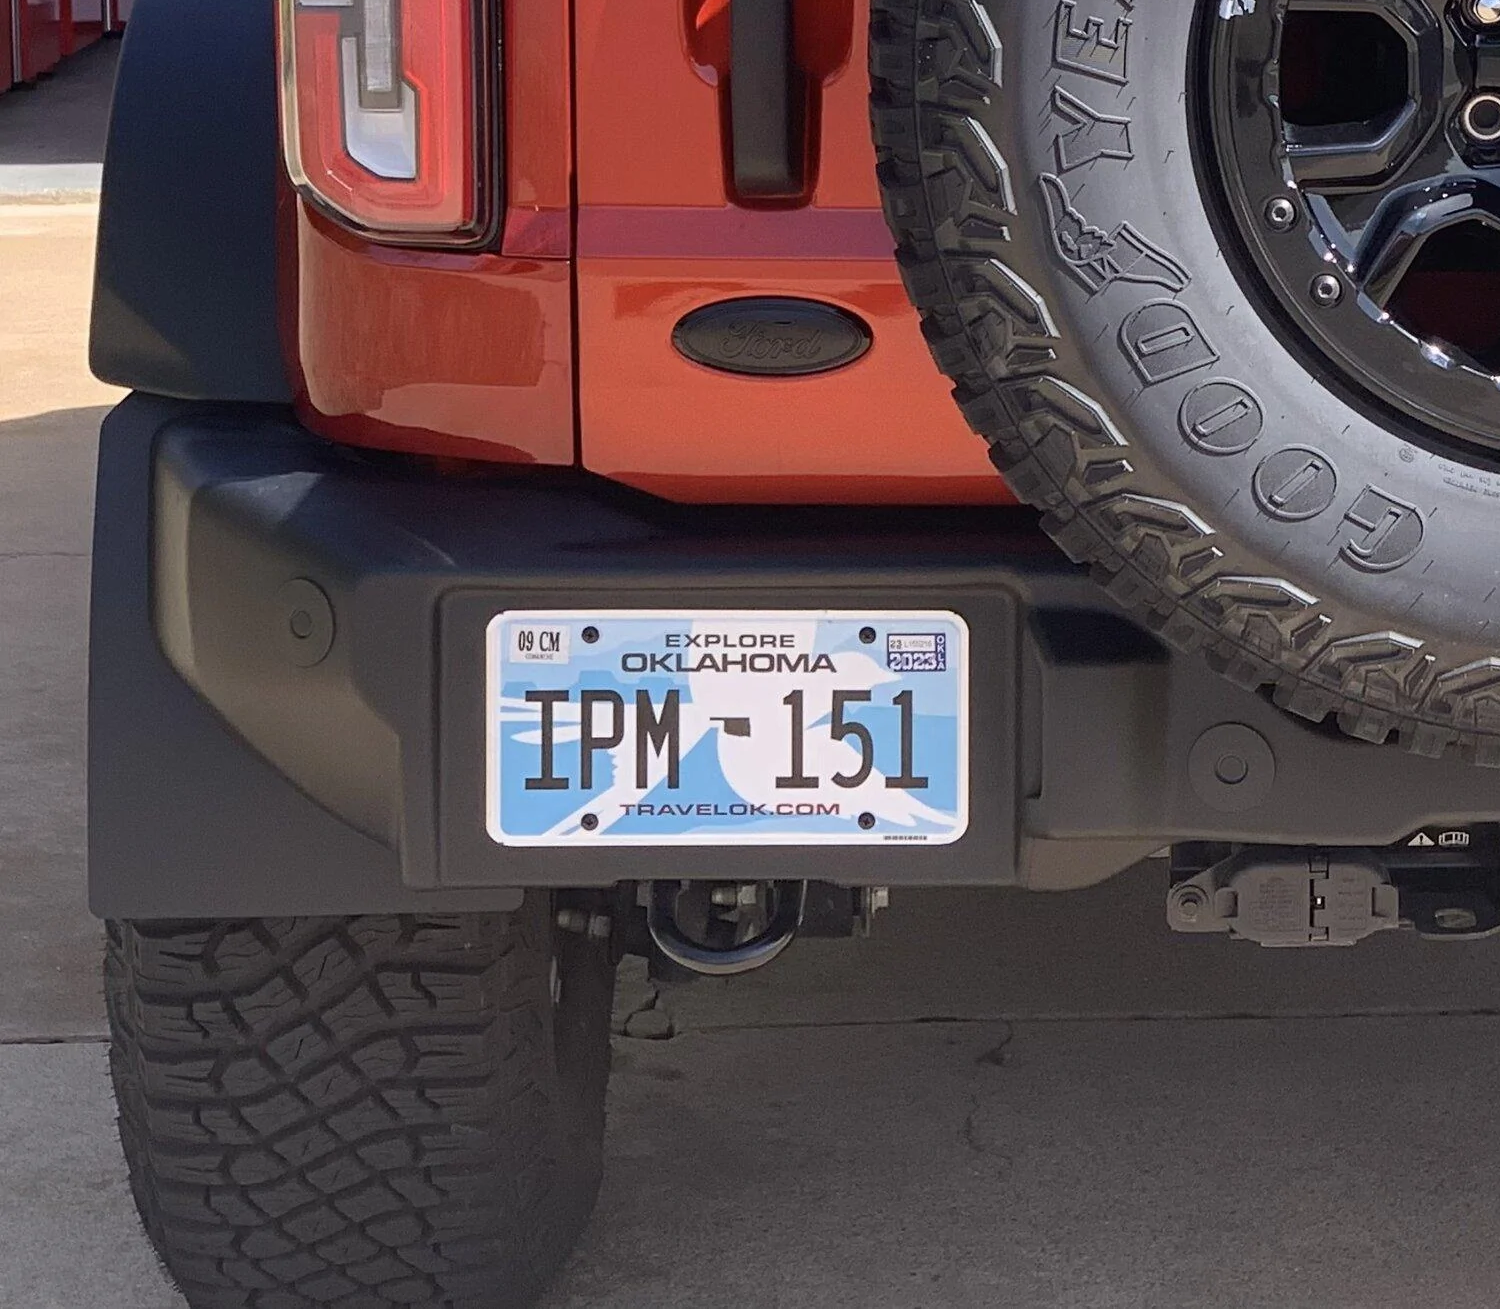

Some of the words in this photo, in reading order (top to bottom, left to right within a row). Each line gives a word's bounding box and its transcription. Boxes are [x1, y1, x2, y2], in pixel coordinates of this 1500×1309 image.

[719, 321, 821, 359] Ford
[518, 630, 534, 652] 09
[539, 631, 560, 652] CM
[665, 634, 795, 648] EXPLORE
[621, 653, 837, 673] OKLAHOMA
[889, 652, 937, 670] 2023
[525, 690, 680, 789] IPM
[775, 690, 929, 789] 151
[620, 803, 840, 817] TRAVELOK.COM
